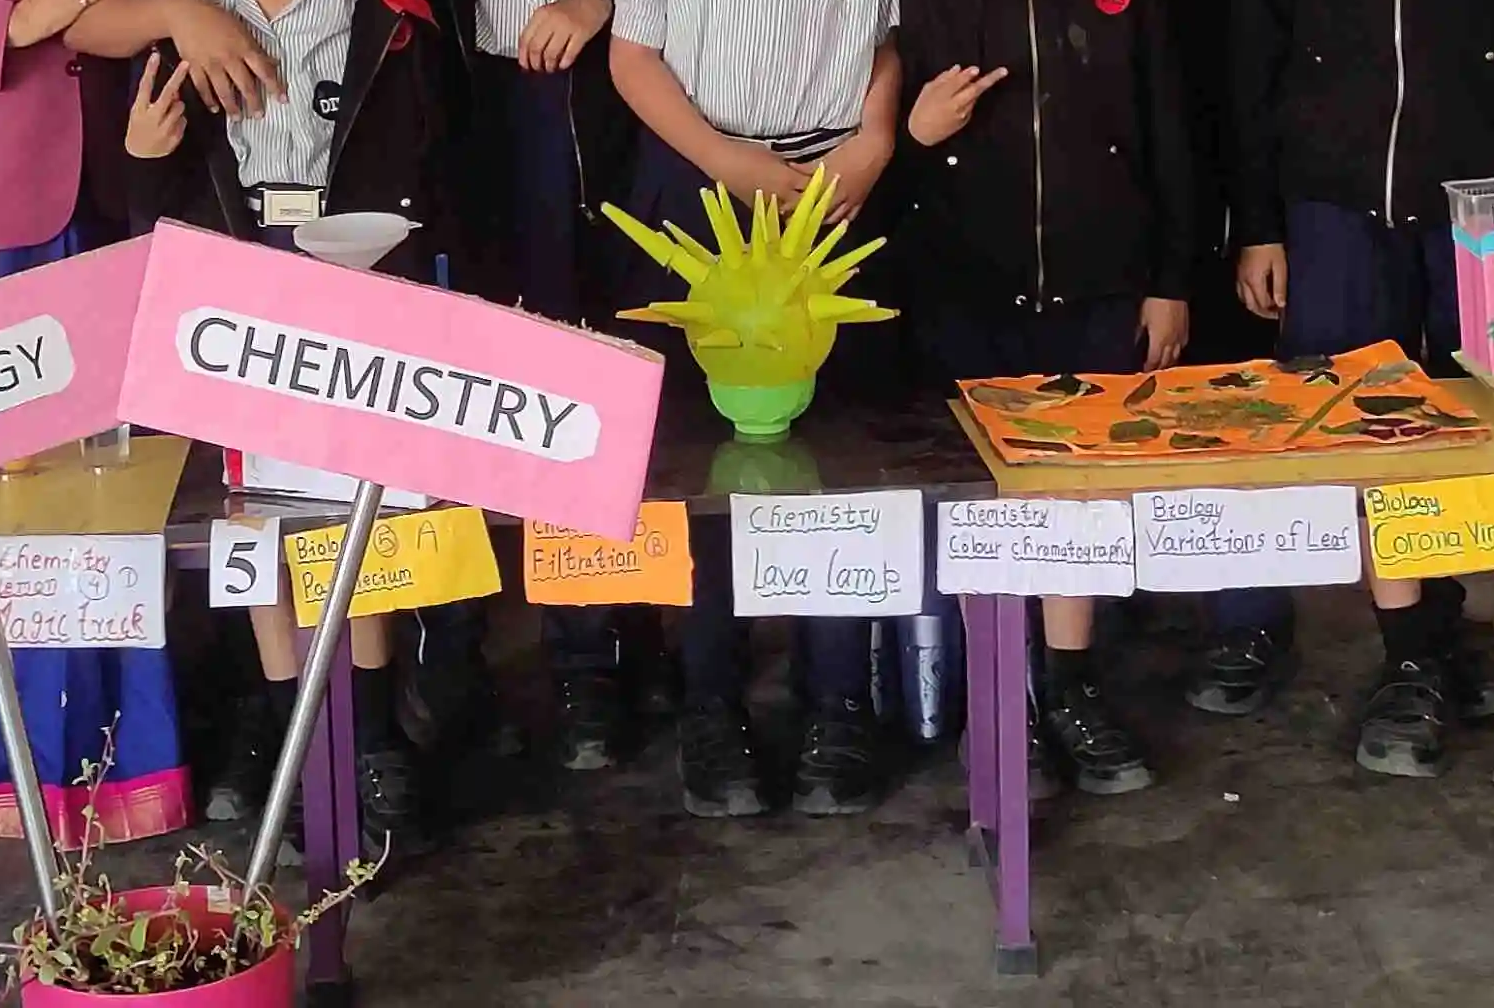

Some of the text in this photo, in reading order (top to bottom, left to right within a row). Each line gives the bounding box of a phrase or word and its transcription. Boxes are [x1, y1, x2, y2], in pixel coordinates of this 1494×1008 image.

[188, 317, 581, 449] CHEMISTRY
[950, 503, 1048, 525] Chemistry
[1151, 495, 1224, 523] Biology
[1370, 487, 1439, 515] Biology
[749, 505, 880, 531] Chemistry
[419, 520, 438, 553] A
[948, 533, 1134, 562] Colour chromatography
[1146, 519, 1349, 551] Variations of Leaf
[1374, 522, 1460, 559] Corona
[224, 542, 258, 594] 5
[532, 549, 639, 579] Filtration
[753, 547, 807, 589] Lava
